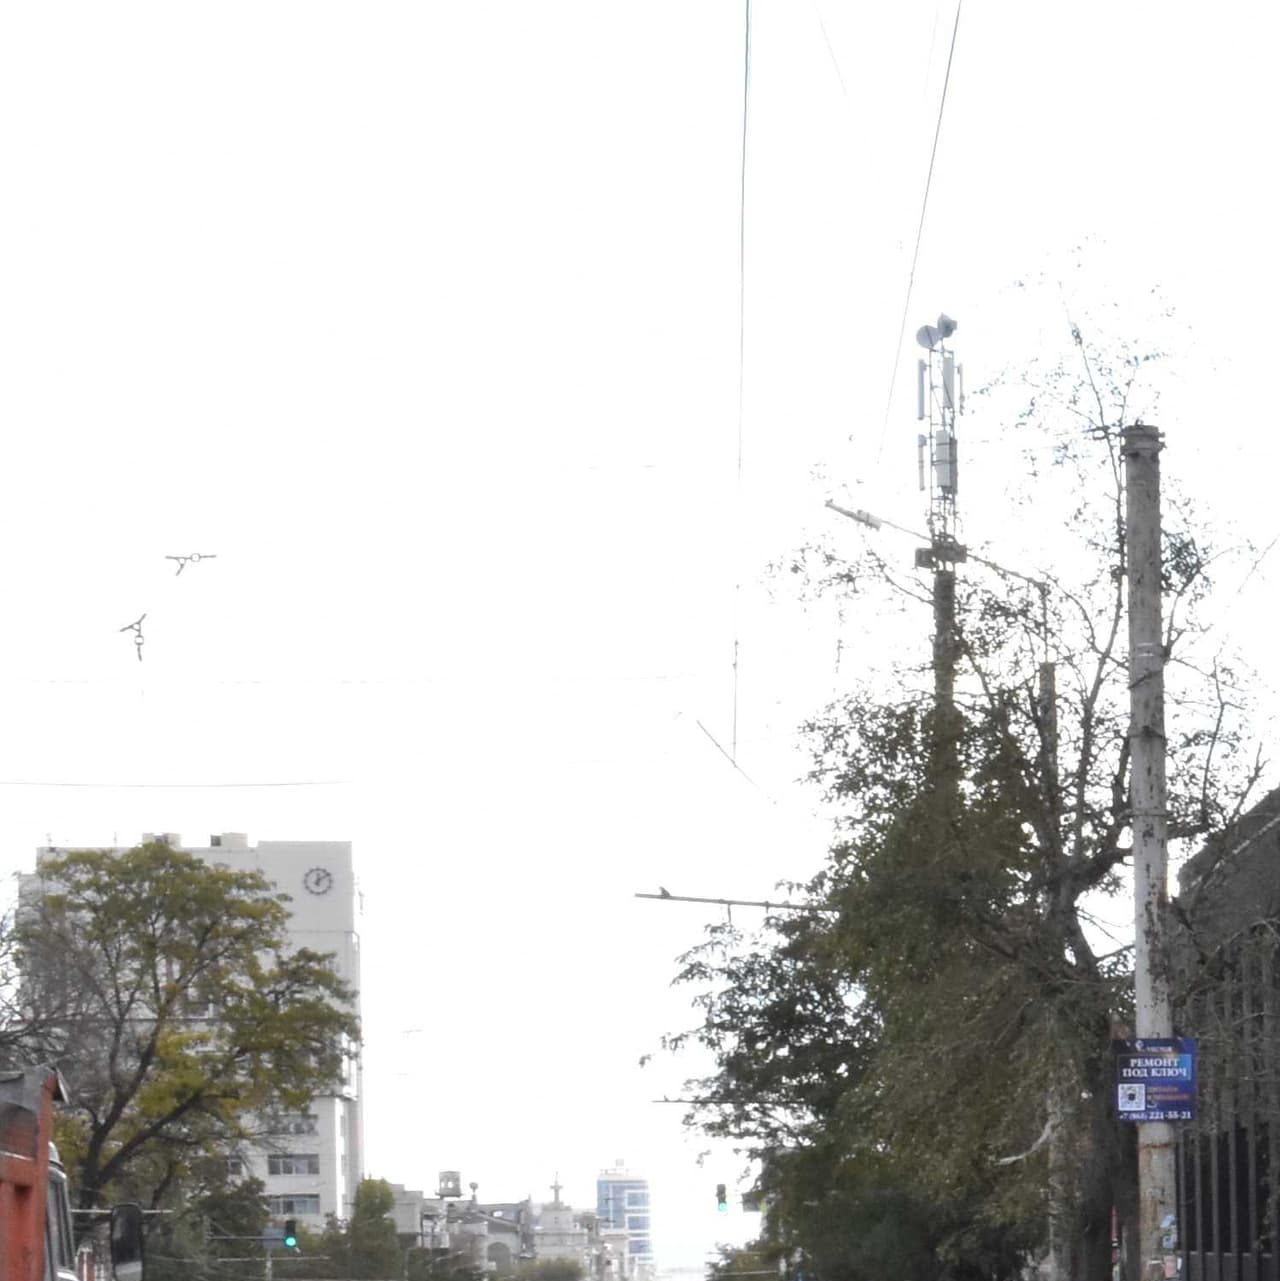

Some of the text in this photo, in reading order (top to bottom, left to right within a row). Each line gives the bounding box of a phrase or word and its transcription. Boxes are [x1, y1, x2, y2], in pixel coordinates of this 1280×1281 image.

[1130, 1058, 1180, 1068] РЕМОНТ
[1122, 1067, 1187, 1078] ПОД КЛЮЧ
